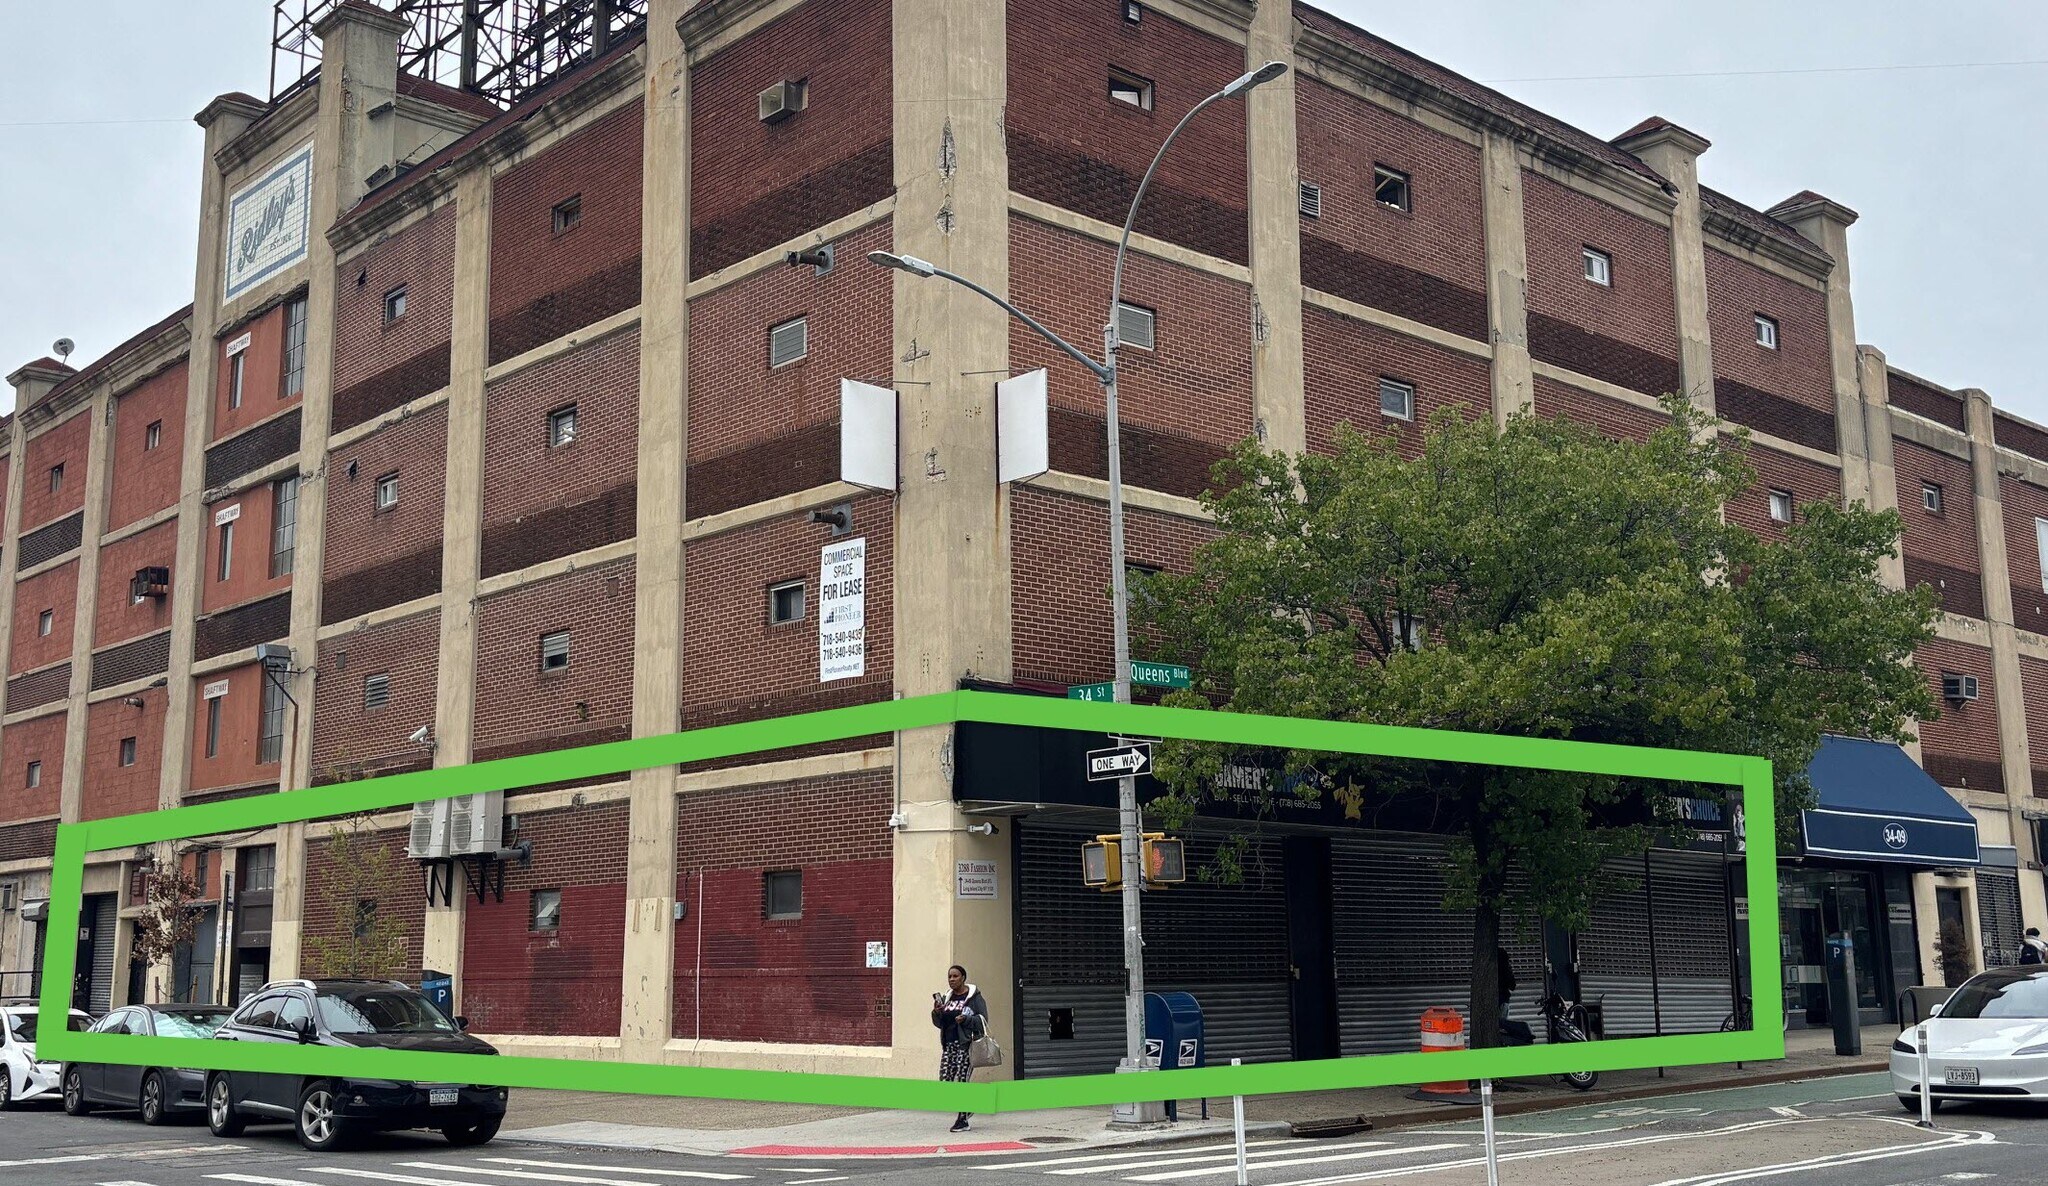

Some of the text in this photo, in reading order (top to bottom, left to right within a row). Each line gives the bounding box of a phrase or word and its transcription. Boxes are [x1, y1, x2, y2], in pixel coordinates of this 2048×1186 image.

[237, 175, 296, 273] Ridley's
[227, 335, 249, 354] SHAFTWAY
[216, 507, 239, 523] SHAFTWAY
[823, 545, 863, 566] COMMERCIAL
[833, 562, 853, 579] SPACE
[823, 577, 863, 601] FOR LEASE
[835, 604, 853, 615] FIRST
[835, 611, 861, 622] PIONEER
[823, 643, 863, 661] 718-540-9436
[1130, 663, 1188, 683] Queens Blvd
[205, 682, 227, 696] SHAFTWAY
[1078, 687, 1105, 701] 34 St
[1096, 754, 1141, 771] ONE WAY
[1233, 794, 1250, 804] SELL
[1253, 796, 1275, 806] TRE
[1690, 798, 1721, 821] CHOICE
[1885, 828, 1906, 843] 34-09
[1833, 947, 1841, 958] P
[438, 989, 447, 1003] P
